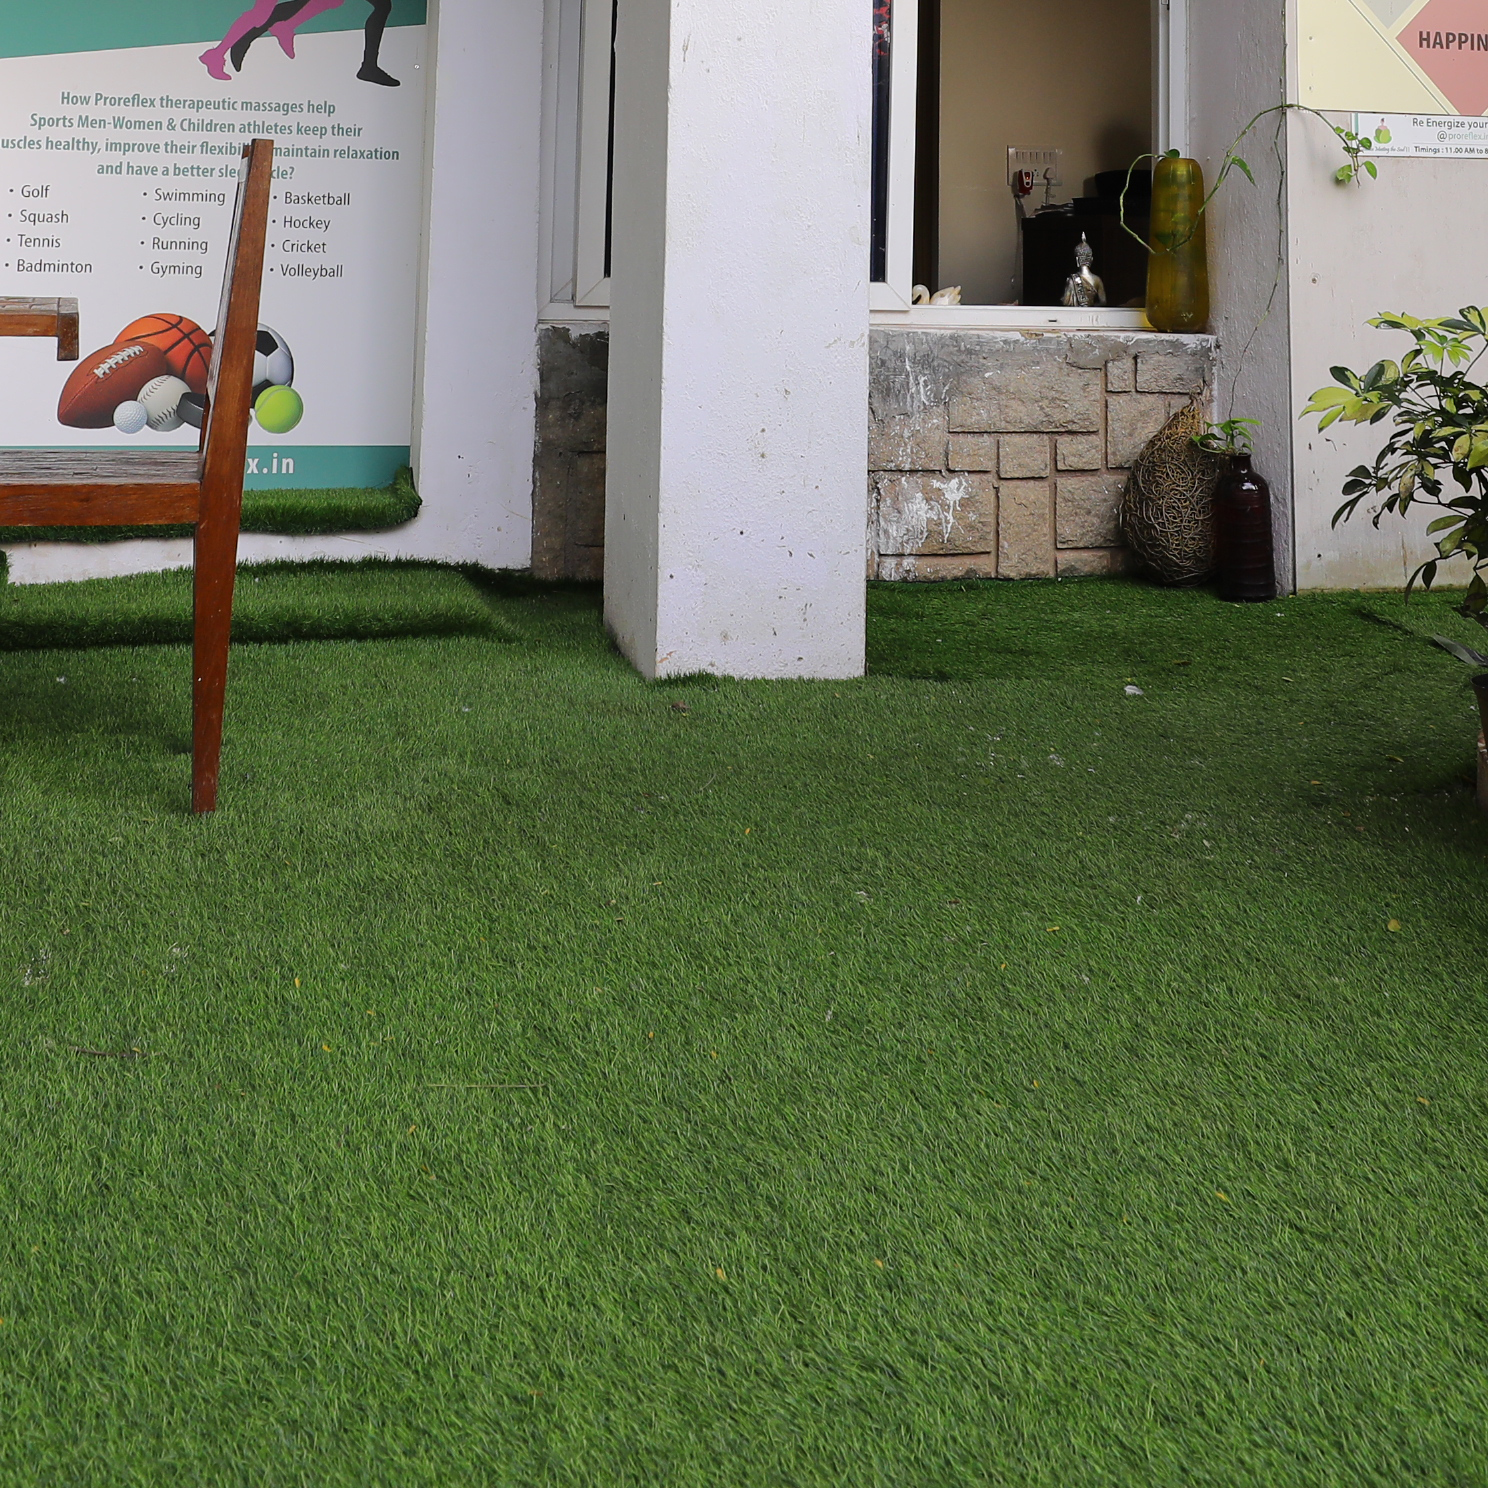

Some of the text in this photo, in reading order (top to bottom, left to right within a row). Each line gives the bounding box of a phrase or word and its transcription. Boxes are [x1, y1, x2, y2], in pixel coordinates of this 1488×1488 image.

[61, 91, 336, 117] How Proreflex therapeutic massages help
[30, 113, 363, 139] Sports Men-Women & Children athletes keep their
[1413, 118, 1424, 127] Re
[1426, 118, 1465, 130] Energize
[1467, 120, 1488, 130] your
[45, 136, 102, 155] healthy,
[105, 138, 160, 155] improve
[164, 140, 197, 155] their
[273, 144, 330, 159] maintain
[333, 145, 400, 160] relaxation
[1414, 146, 1440, 155] Timings
[97, 162, 123, 175] and
[126, 162, 158, 176] have
[162, 166, 169, 176] a
[173, 163, 215, 178] better
[218, 164, 241, 178] sle
[20, 185, 50, 199] Golf
[154, 188, 226, 206] Swimming
[284, 191, 350, 206] Basketball
[19, 209, 69, 227] Squash
[153, 212, 201, 230] Cycling
[283, 215, 331, 232] Hockey
[17, 235, 61, 249] Tennis
[152, 237, 208, 254] Running
[282, 240, 327, 254] Cricket
[16, 259, 93, 274] Badminton
[150, 261, 203, 279] Gyming
[280, 264, 344, 280] Volleyball
